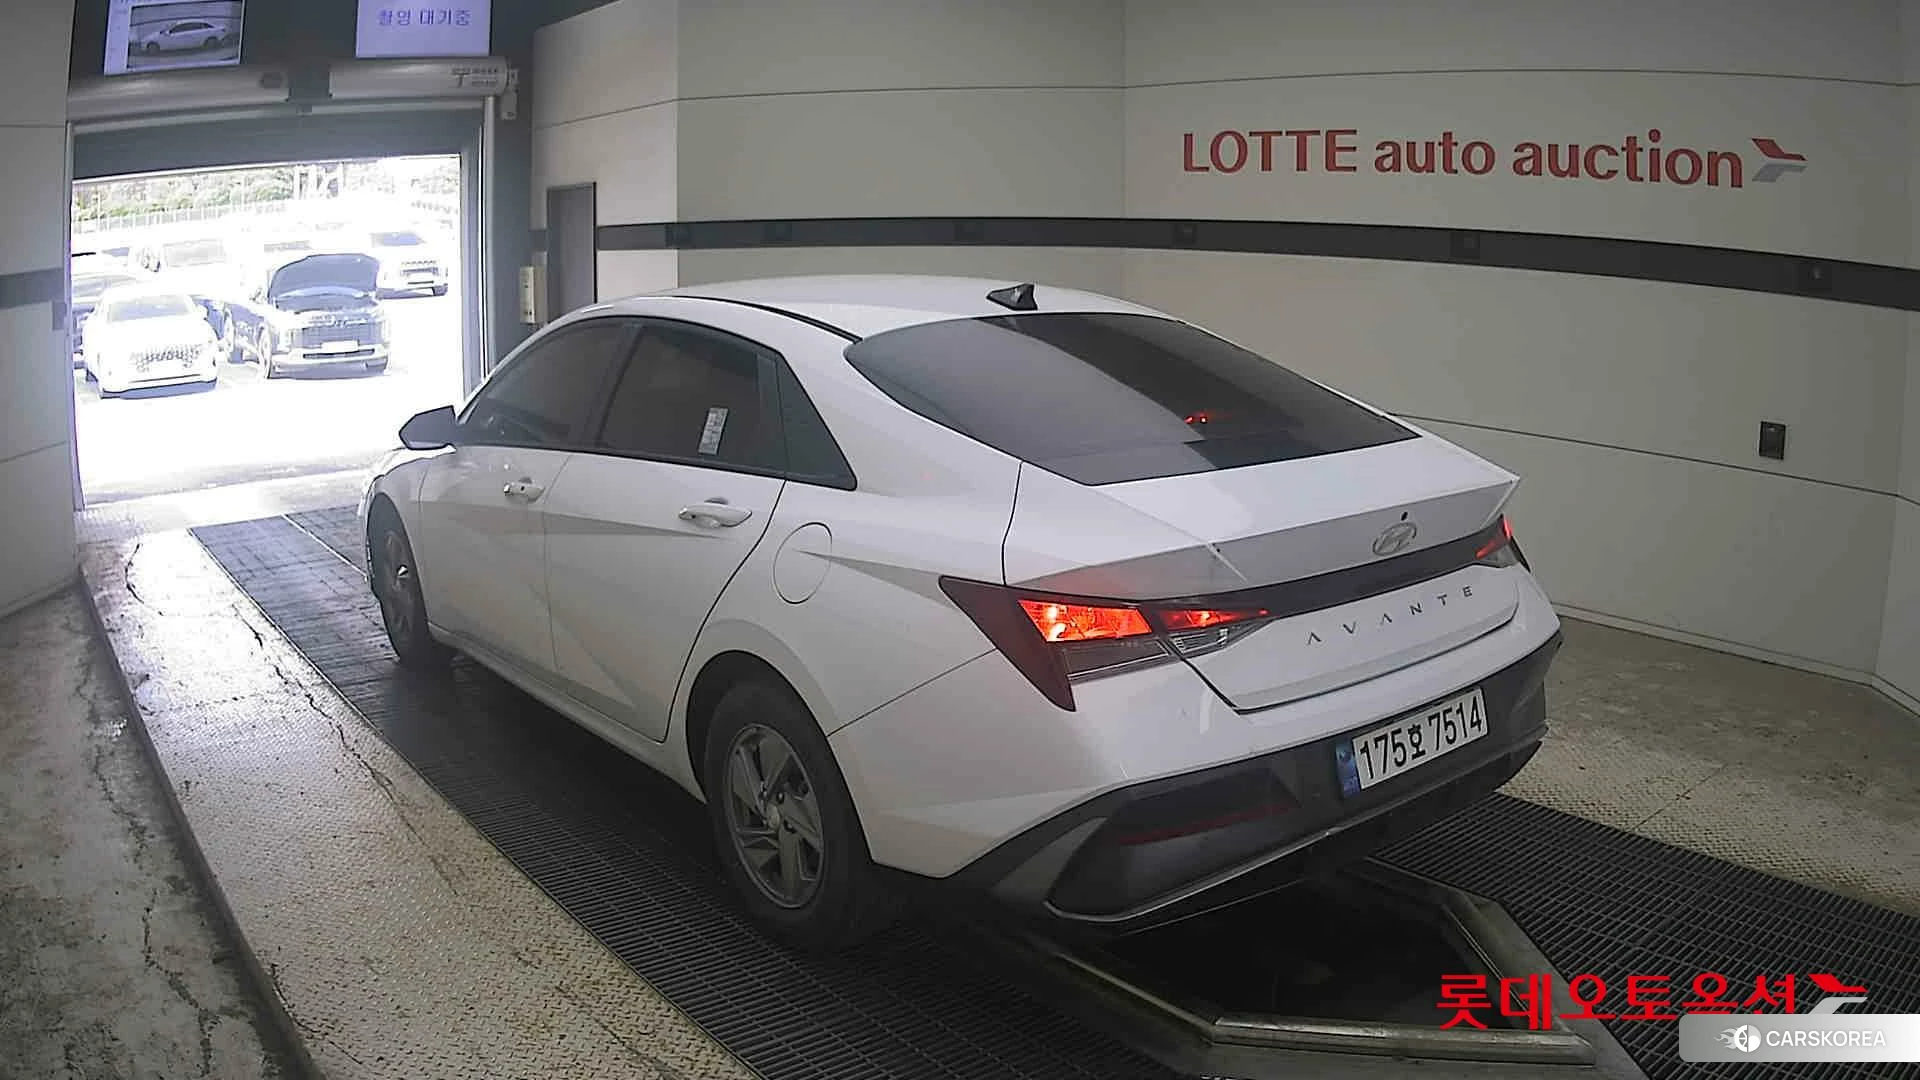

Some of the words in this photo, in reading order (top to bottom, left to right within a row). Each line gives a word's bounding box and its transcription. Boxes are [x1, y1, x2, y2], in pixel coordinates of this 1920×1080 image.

[1183, 128, 1358, 173] LOTTE
[1374, 131, 1496, 175] auto
[1512, 128, 1744, 189] auction
[1306, 585, 1474, 645] AVANTE
[1359, 723, 1427, 780] 175호
[1428, 695, 1483, 751] 7514
